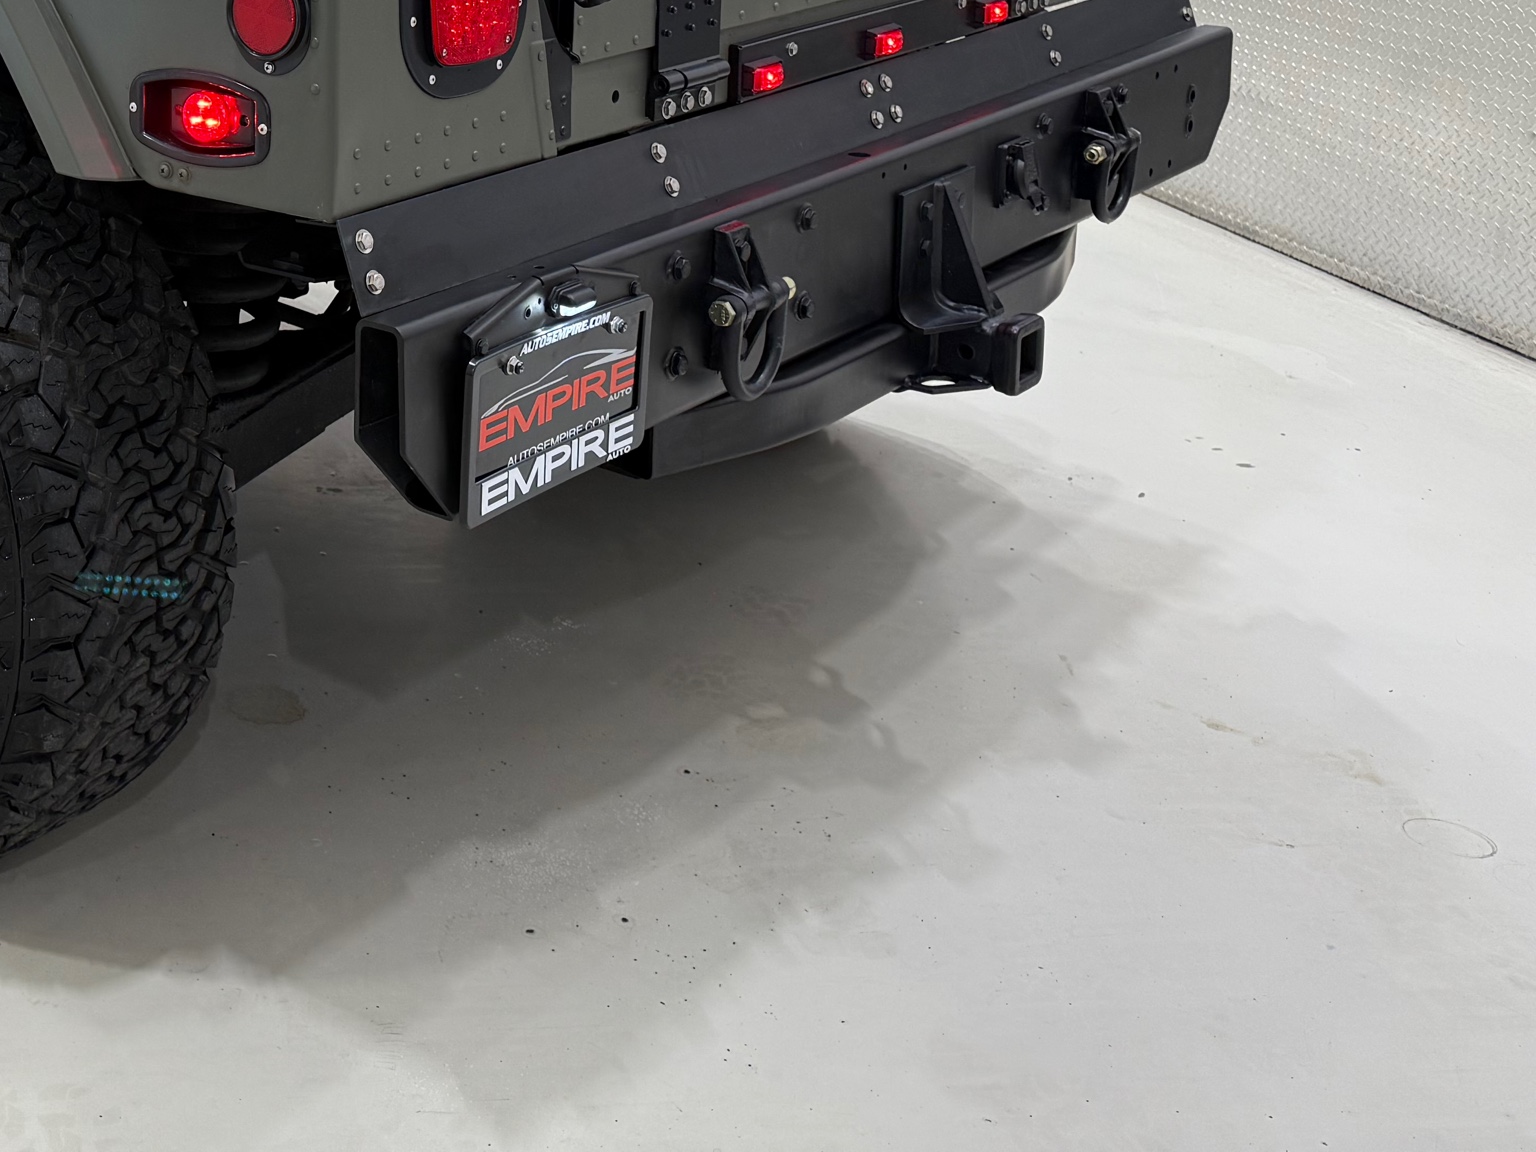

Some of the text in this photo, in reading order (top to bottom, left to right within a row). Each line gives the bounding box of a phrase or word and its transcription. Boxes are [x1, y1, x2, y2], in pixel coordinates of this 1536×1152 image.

[519, 311, 612, 357] AUTOSEMPIRE.COM
[478, 354, 637, 453] EMPIRE
[607, 386, 633, 403] AUTO
[507, 412, 610, 467] AUTOSEMPIRECOM
[606, 445, 632, 462] AUTO
[480, 413, 635, 517] EMPIRE
